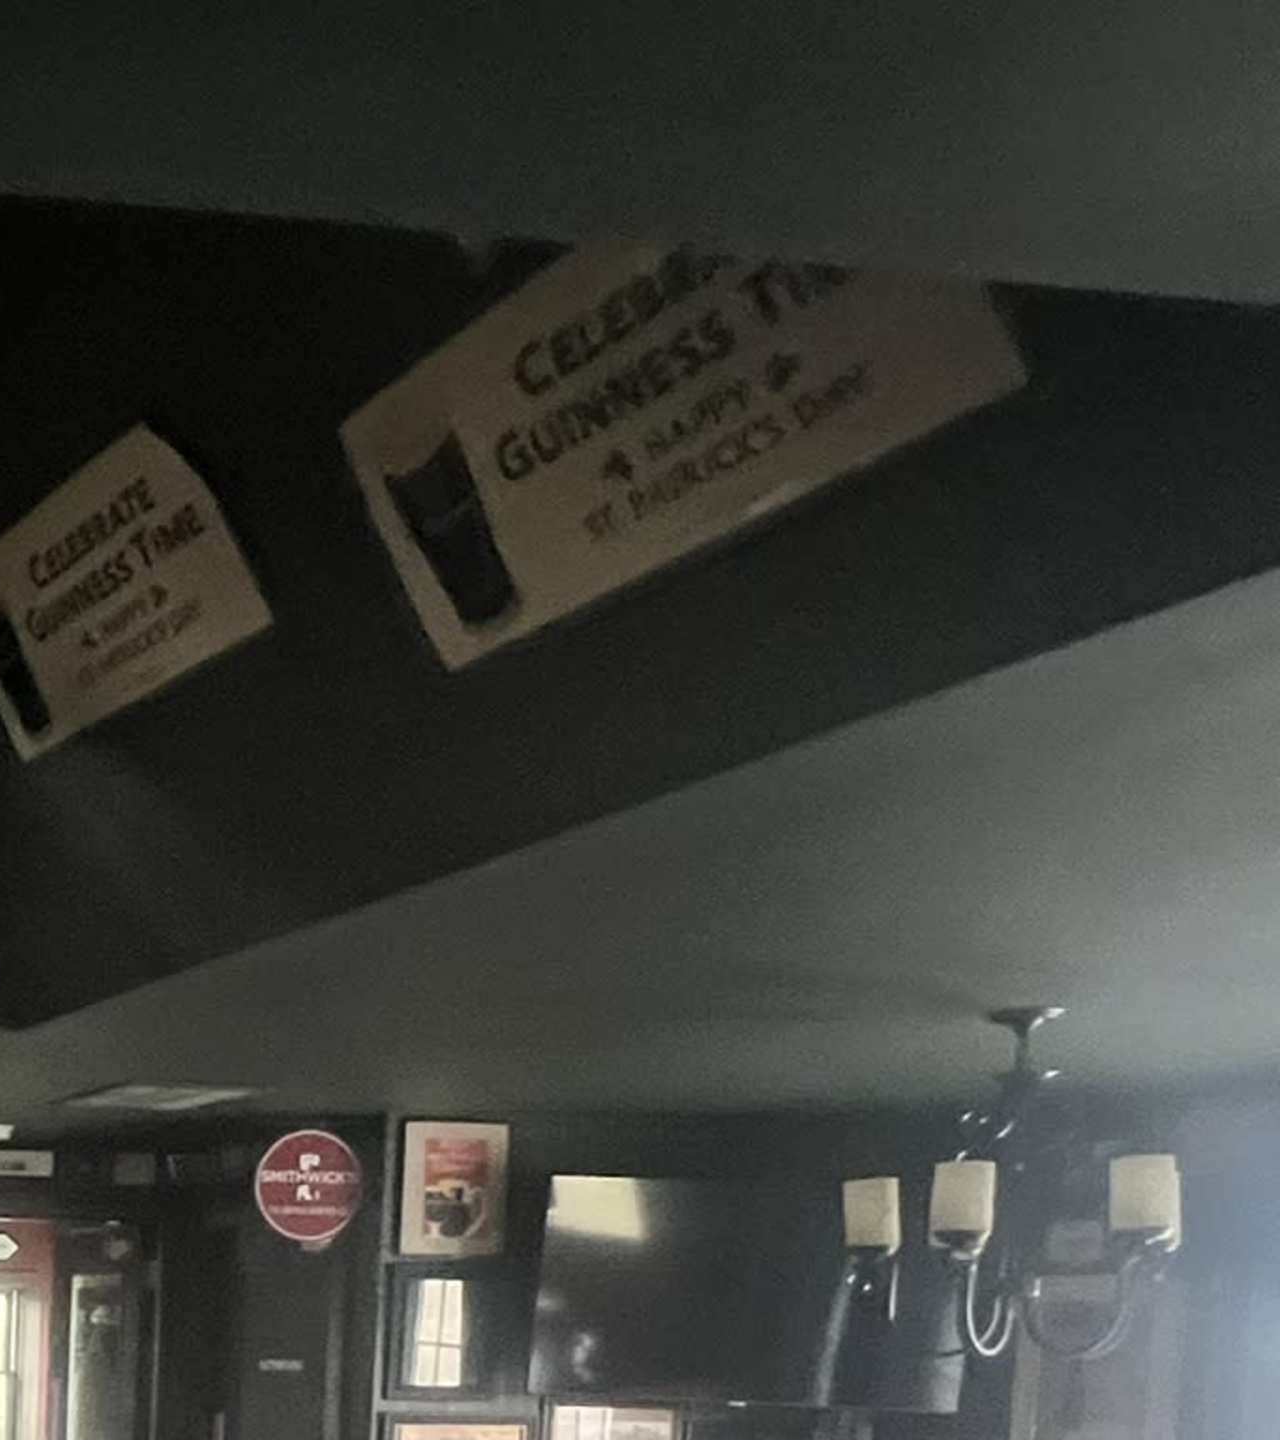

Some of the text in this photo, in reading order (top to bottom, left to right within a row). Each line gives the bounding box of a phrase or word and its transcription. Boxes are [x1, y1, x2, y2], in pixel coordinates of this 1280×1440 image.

[496, 309, 736, 481] GUINNESS
[26, 550, 134, 642] GUINNESS
[129, 503, 205, 569] TIME
[29, 476, 155, 588] CELEBRATE
